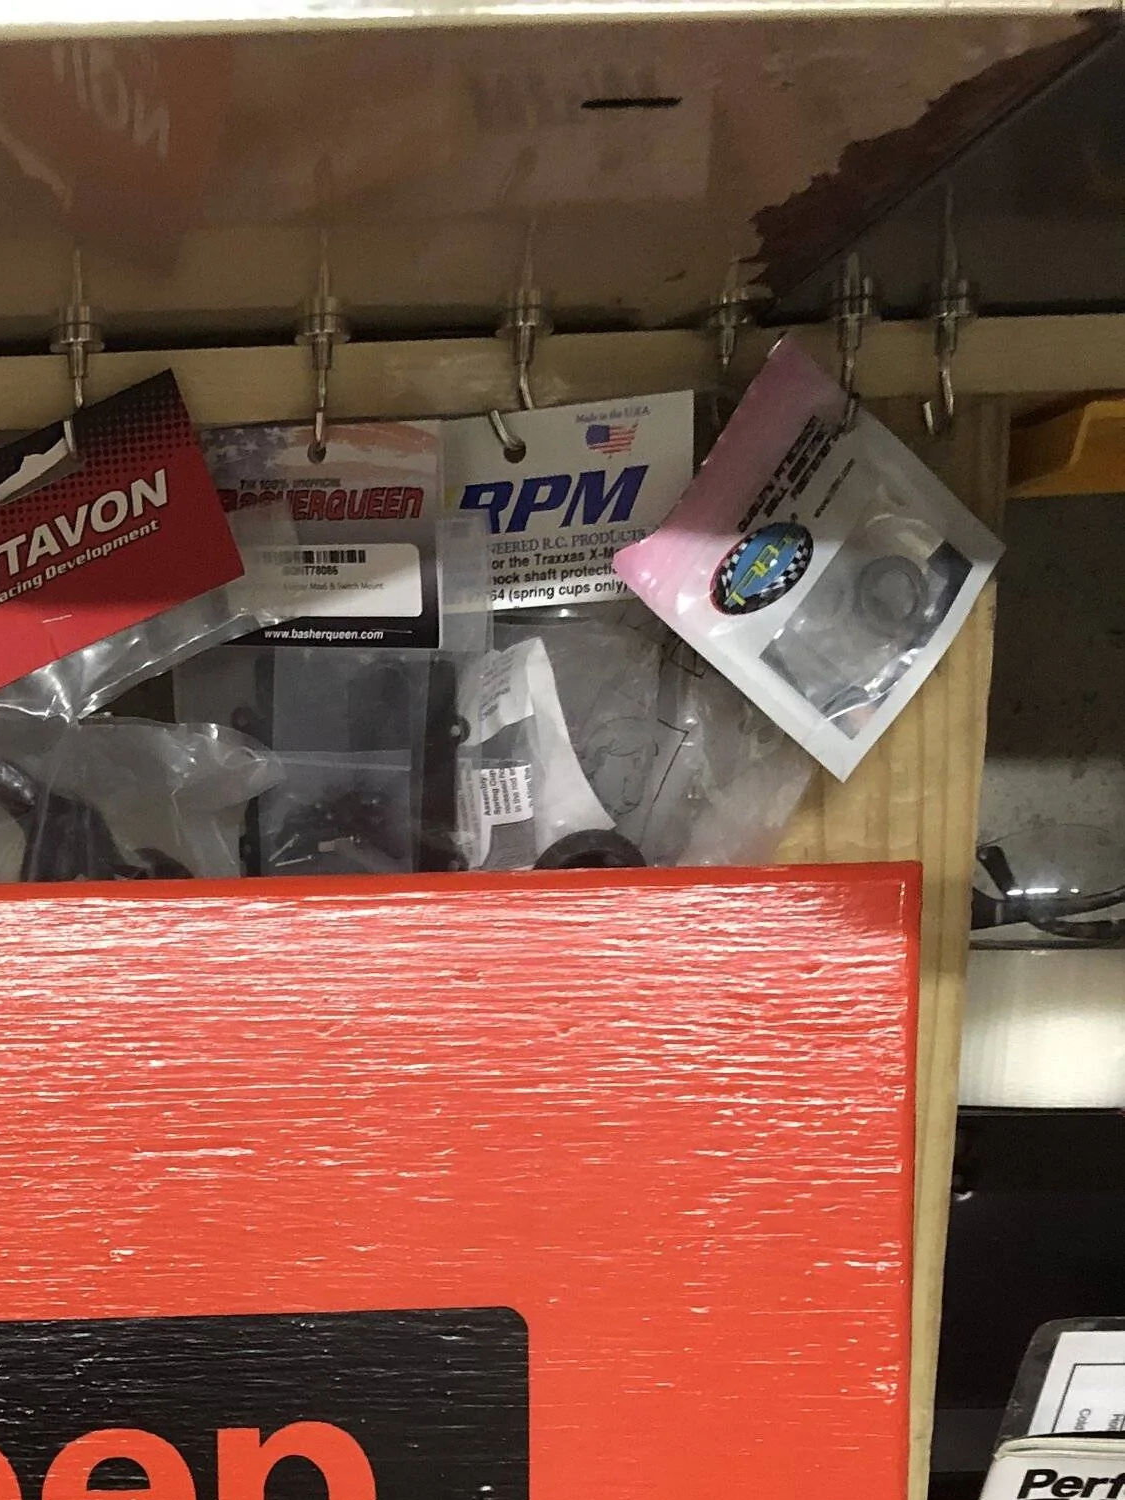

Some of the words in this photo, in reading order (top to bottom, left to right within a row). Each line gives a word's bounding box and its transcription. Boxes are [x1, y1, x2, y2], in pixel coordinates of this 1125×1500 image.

[217, 486, 425, 521] BAERQUEEN
[459, 464, 649, 534] RPM
[572, 529, 646, 547] PRODUCTS
[45, 518, 161, 581] Development
[509, 553, 530, 568] the
[535, 551, 586, 566] Traxxas
[590, 546, 619, 560] X-M
[525, 569, 557, 583] shaft
[508, 586, 555, 602] (spring
[559, 583, 591, 597] cups
[264, 628, 384, 642] www.basherqueen.com
